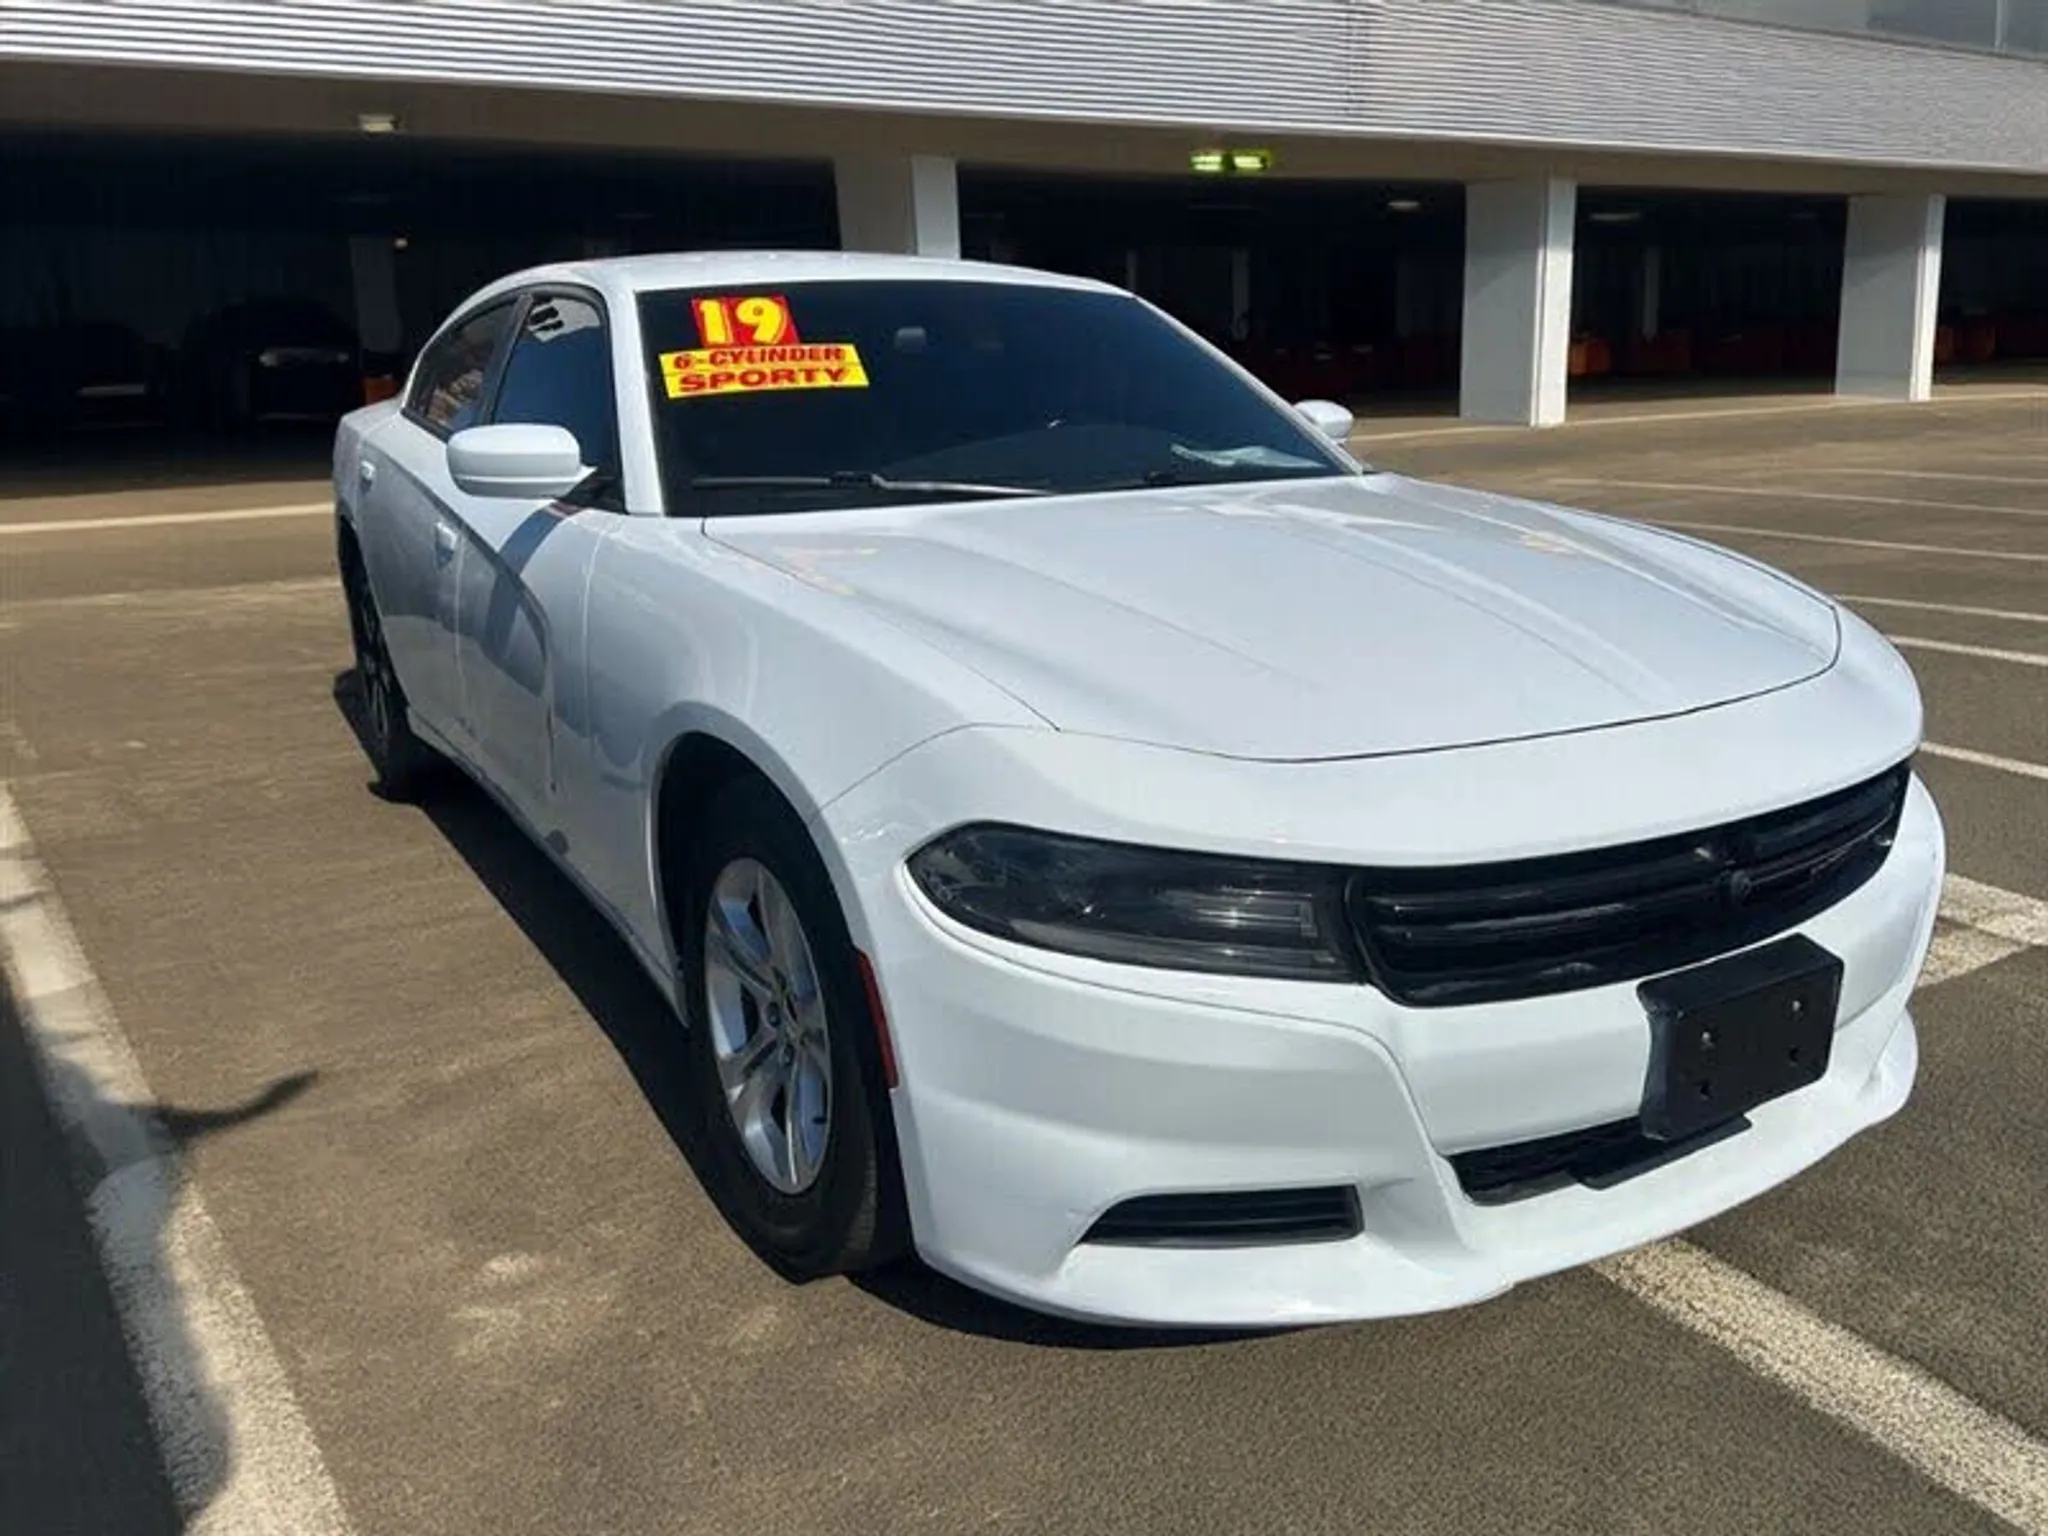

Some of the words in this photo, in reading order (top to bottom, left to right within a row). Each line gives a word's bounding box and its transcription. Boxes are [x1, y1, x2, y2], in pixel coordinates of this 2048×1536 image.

[700, 297, 786, 344] 19
[673, 347, 843, 370] 6-CYLINDER
[679, 368, 845, 392] SPORTY
